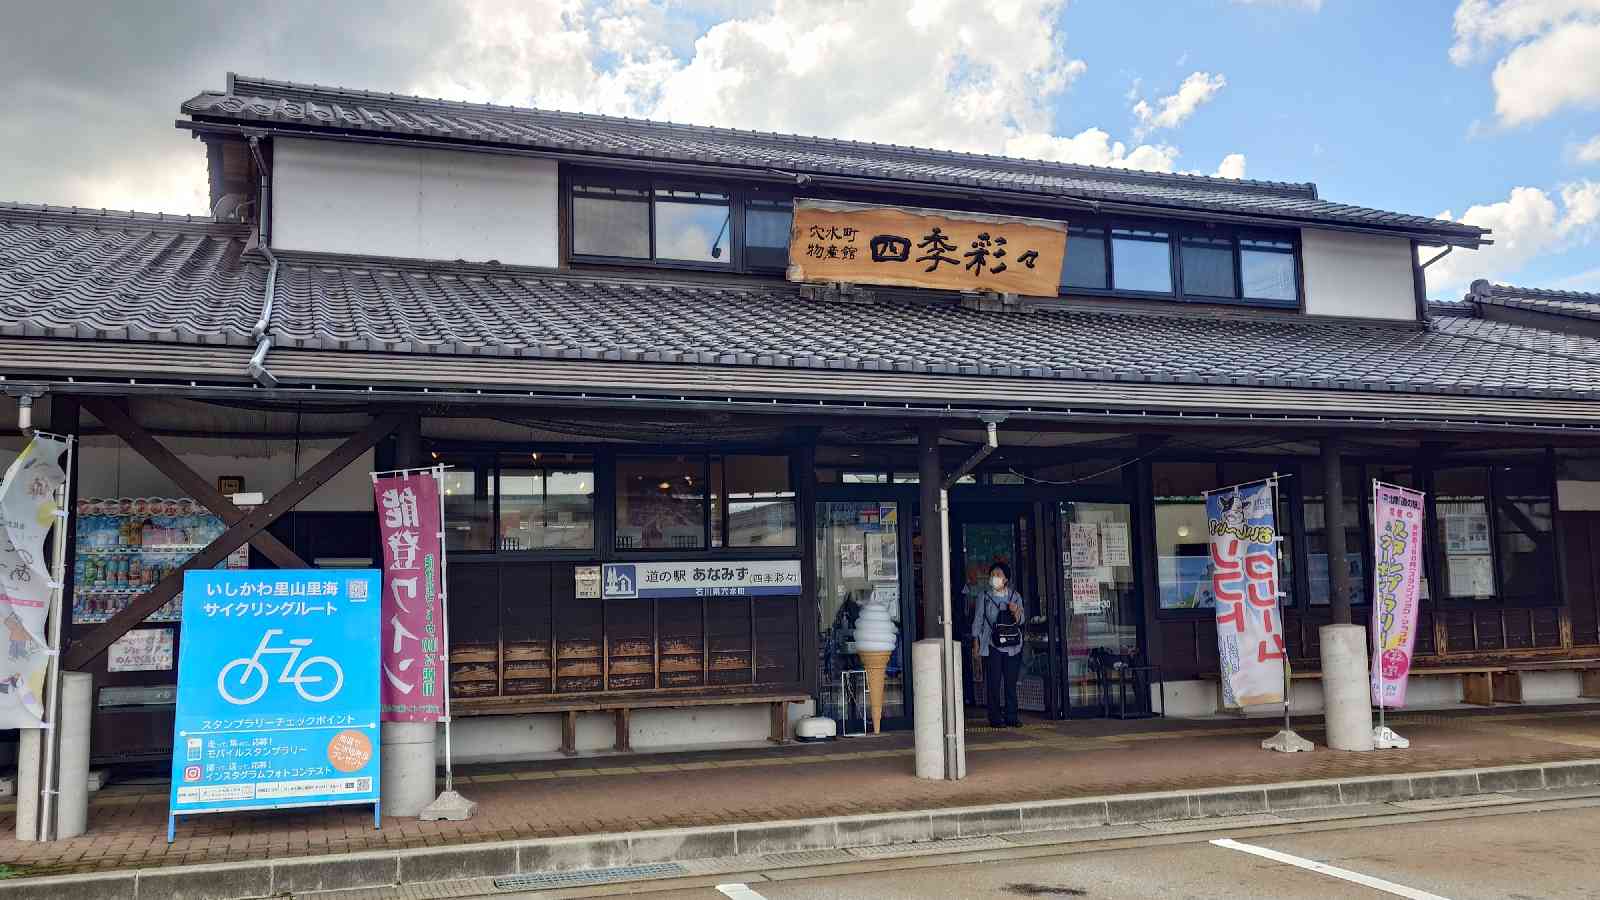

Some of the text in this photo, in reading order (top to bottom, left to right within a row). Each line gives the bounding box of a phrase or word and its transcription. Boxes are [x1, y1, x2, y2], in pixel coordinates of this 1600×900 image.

[809, 224, 861, 242] 穴水町
[806, 243, 858, 261] 物産館
[869, 226, 1040, 277] 四季彩々
[645, 568, 688, 584] 道の駅
[692, 566, 749, 582] あなみず
[206, 582, 339, 598] いしかわ里山里海
[203, 601, 338, 617] サイクリングルート
[201, 714, 355, 731] スタンプラリーチェックポイント
